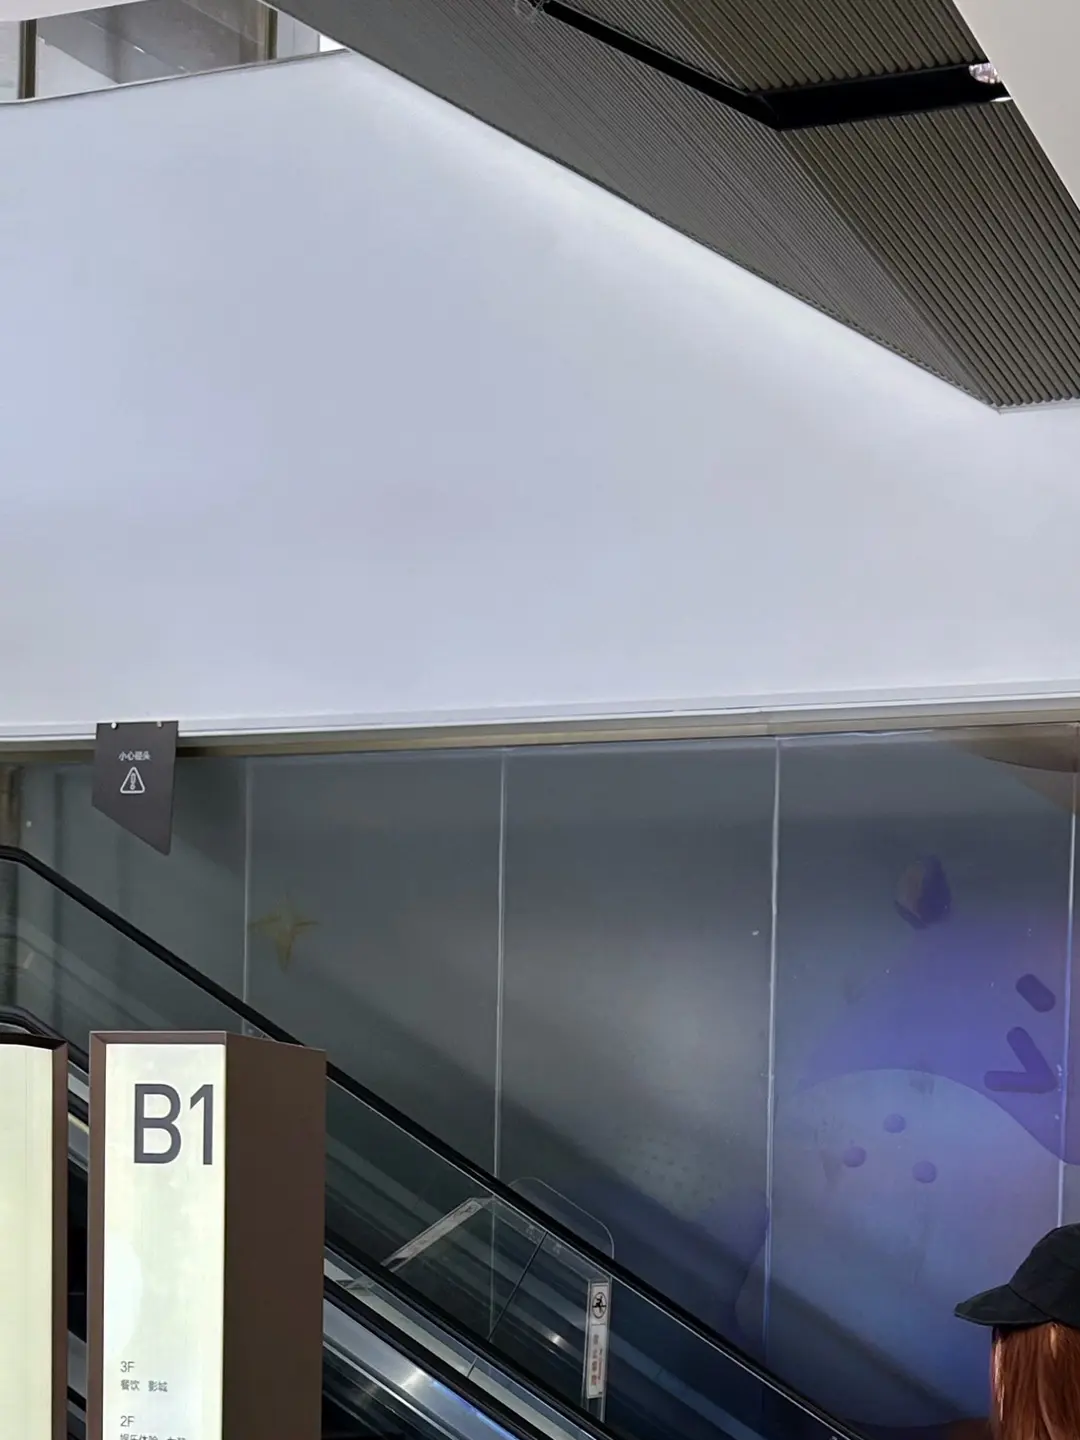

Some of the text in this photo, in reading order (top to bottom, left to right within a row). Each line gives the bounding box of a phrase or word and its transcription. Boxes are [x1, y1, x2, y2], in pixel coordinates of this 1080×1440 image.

[133, 1083, 214, 1166] B1
[120, 1360, 135, 1373] 3F
[120, 1379, 140, 1391] 餐饮
[120, 1415, 135, 1428] 2F
